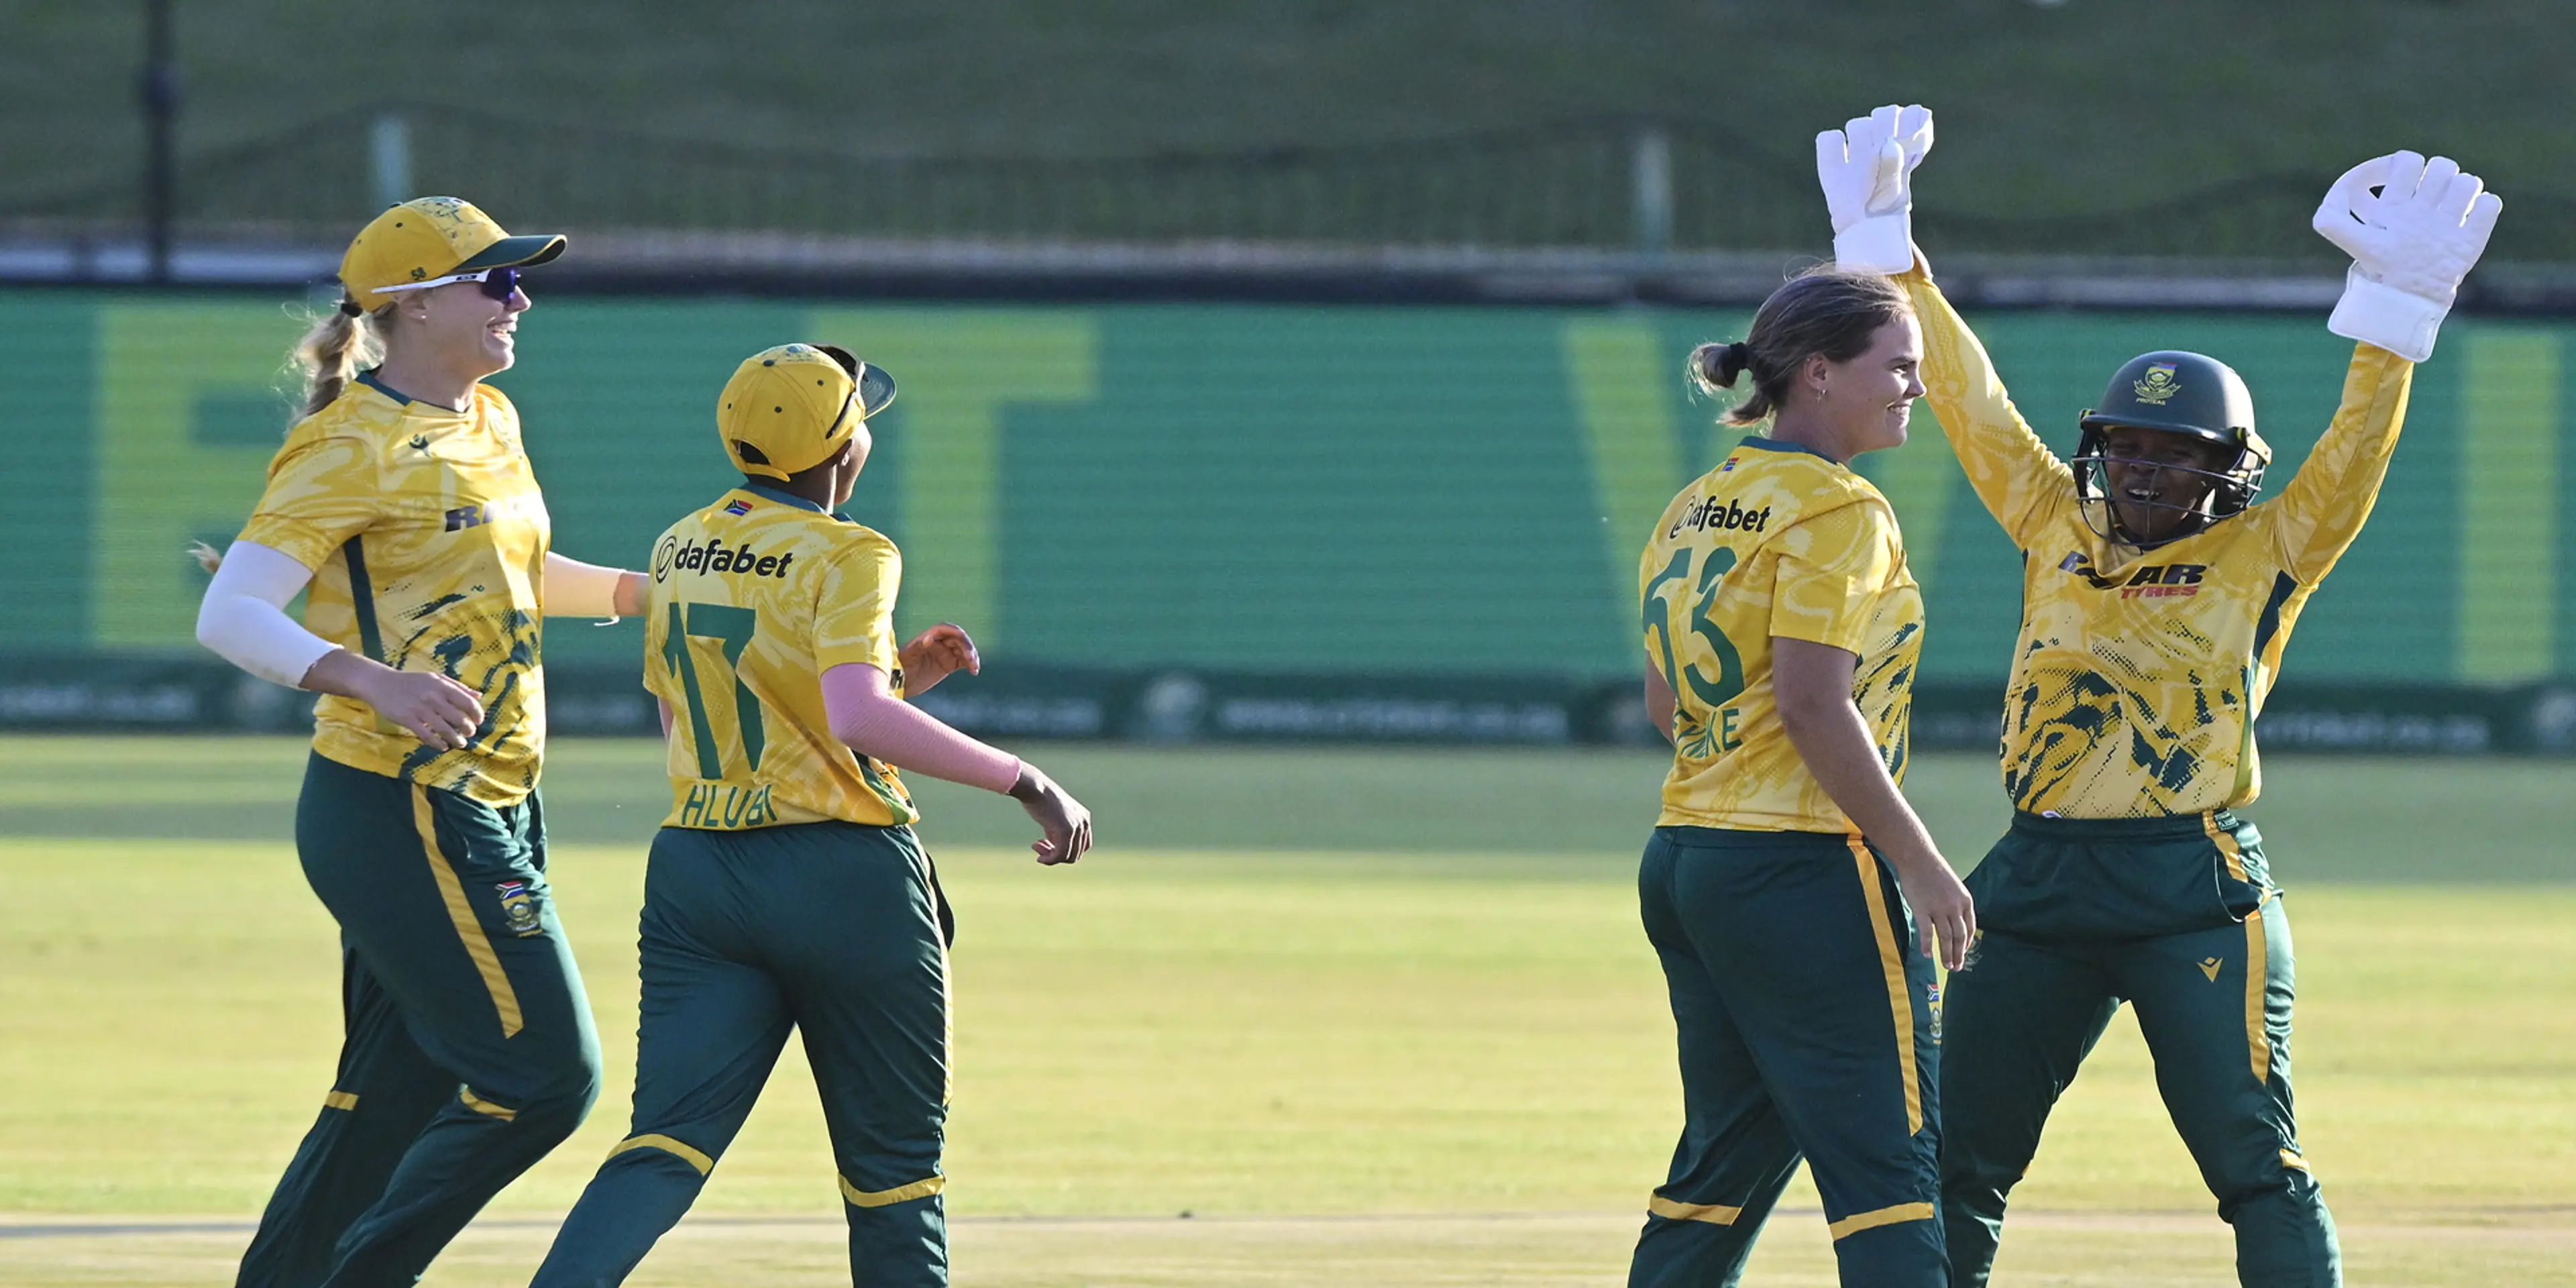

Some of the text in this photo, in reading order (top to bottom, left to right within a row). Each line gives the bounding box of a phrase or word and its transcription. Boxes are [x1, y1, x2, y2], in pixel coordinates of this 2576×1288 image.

[674, 538, 793, 578] dafabet
[2121, 585, 2200, 600] TYRES
[662, 602, 766, 780] 17
